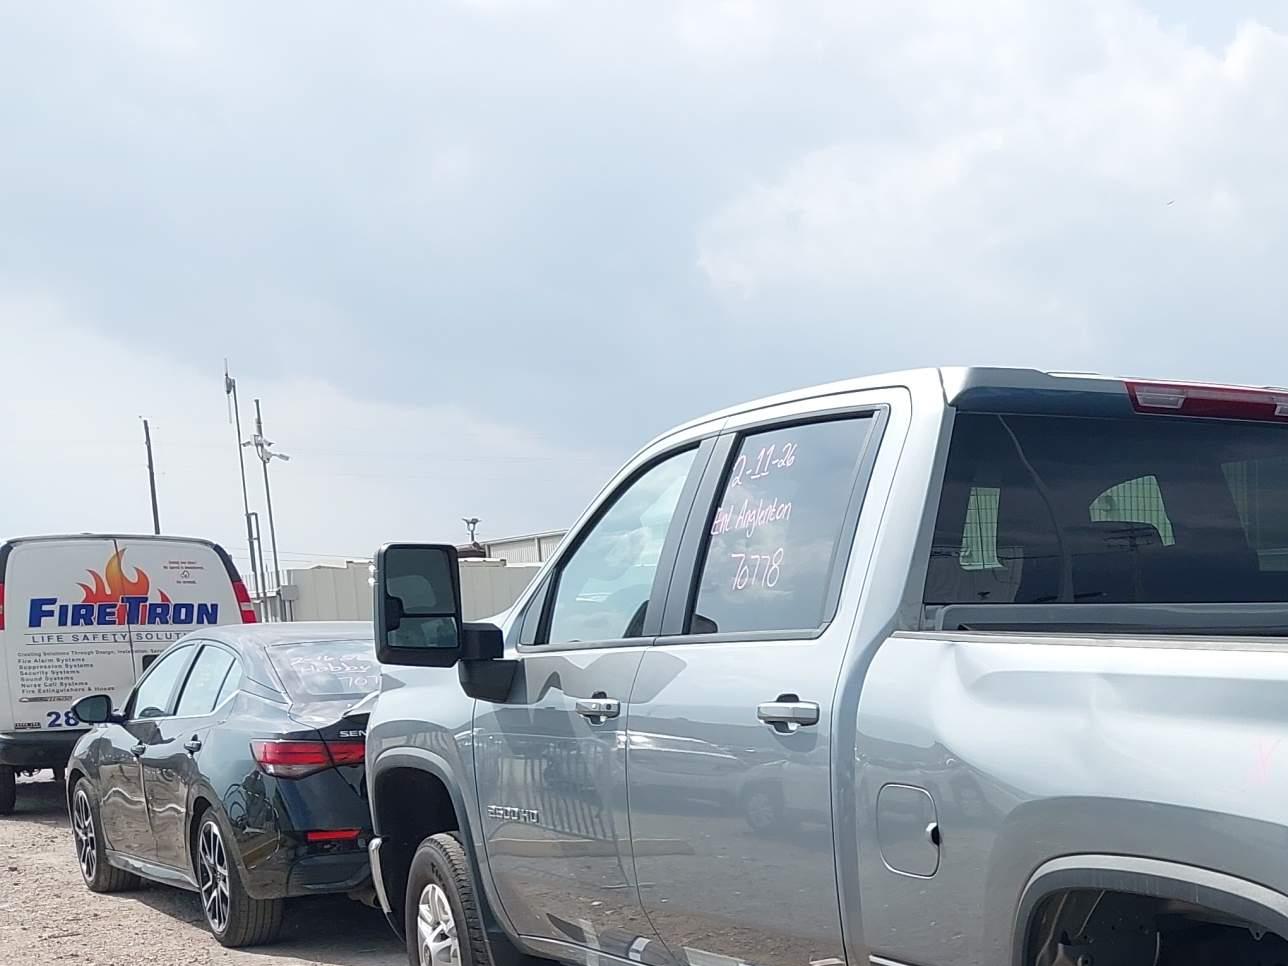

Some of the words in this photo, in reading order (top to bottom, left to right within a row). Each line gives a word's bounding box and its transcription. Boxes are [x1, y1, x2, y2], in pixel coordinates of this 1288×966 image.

[32, 633, 64, 643] LIFE
[72, 632, 128, 643] SAFETY
[56, 656, 86, 664] Systems
[65, 662, 94, 670] Systems
[45, 675, 74, 683] Systems
[60, 680, 89, 688] Systems
